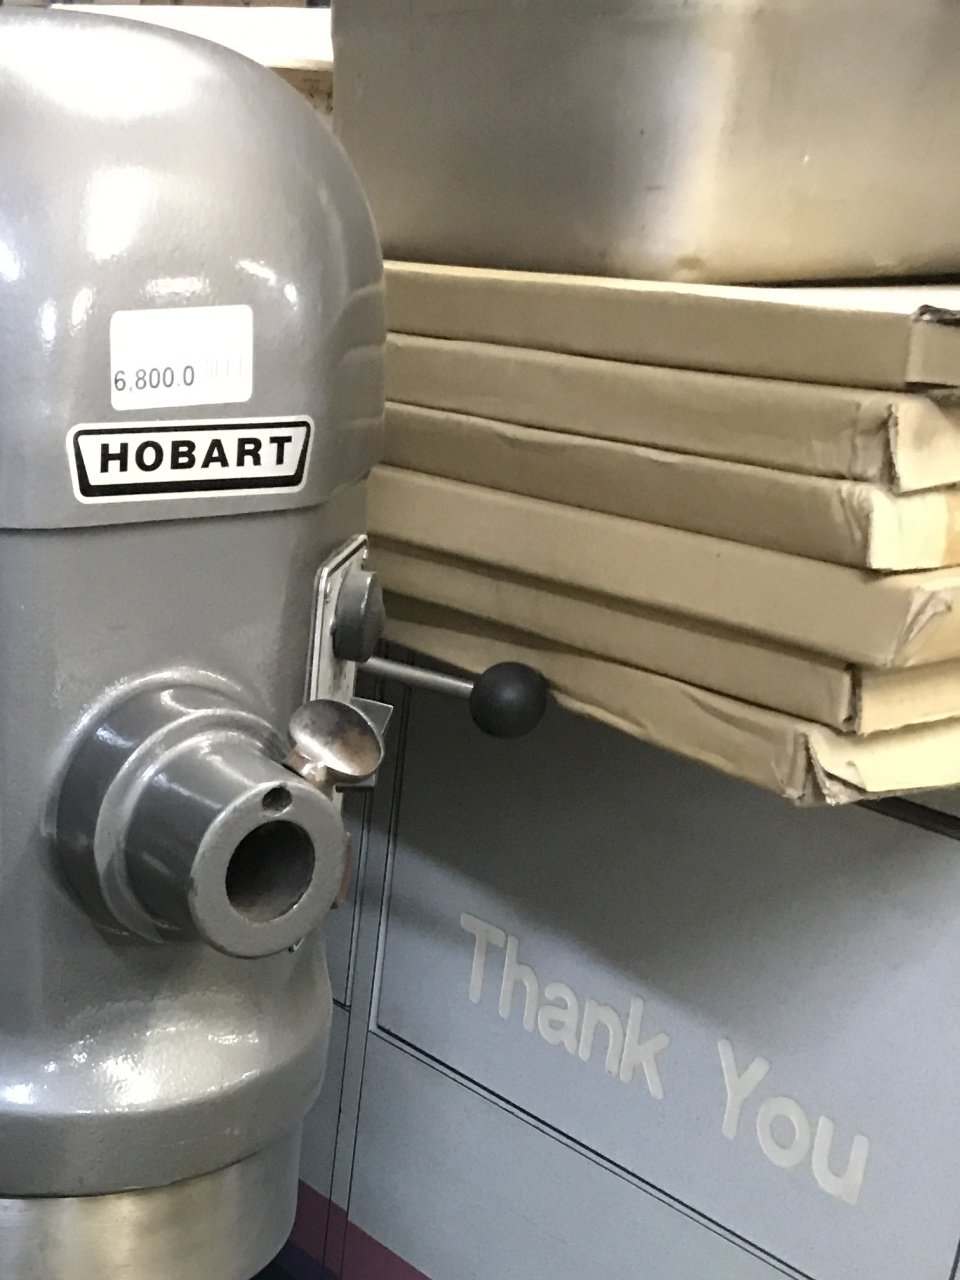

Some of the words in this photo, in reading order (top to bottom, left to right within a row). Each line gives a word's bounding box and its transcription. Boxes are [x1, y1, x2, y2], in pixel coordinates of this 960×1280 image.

[99, 435, 293, 474] HOBART
[460, 911, 670, 1100] Thank
[716, 1037, 871, 1206] You
